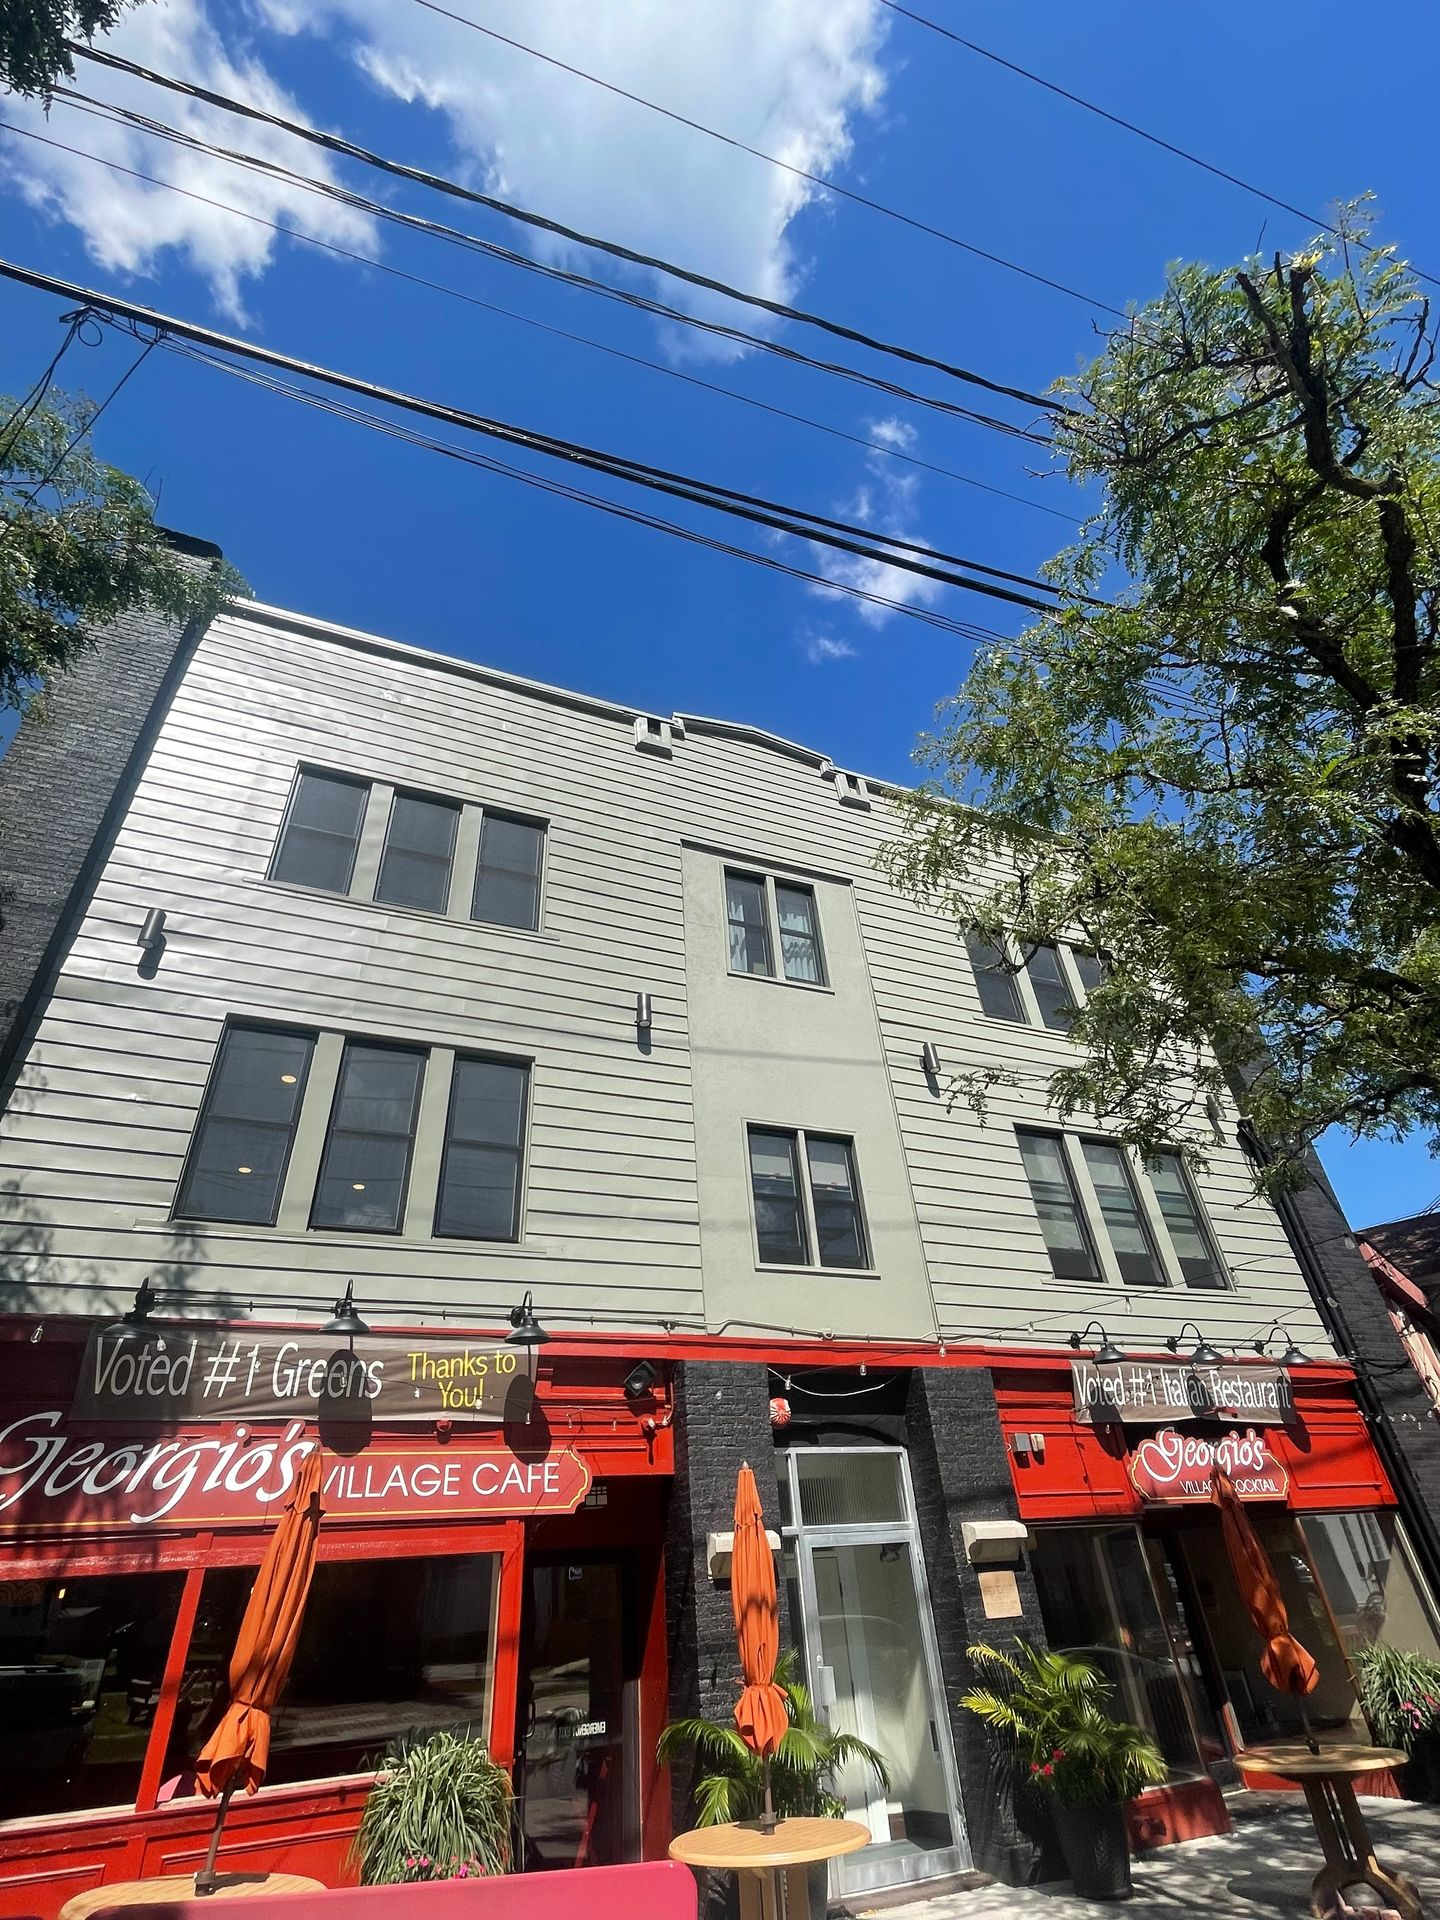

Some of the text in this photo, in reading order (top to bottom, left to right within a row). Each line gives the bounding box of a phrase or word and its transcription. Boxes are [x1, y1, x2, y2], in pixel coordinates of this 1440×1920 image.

[94, 1336, 385, 1399] Voted #1 Greens
[407, 1350, 517, 1381] Thanks to
[1073, 1364, 1292, 1409] Voted #1 Italian Restaurant
[438, 1378, 484, 1409] You!
[0, 1411, 317, 1524] Georgio's
[472, 1462, 560, 1495] CAFE
[1141, 1426, 1265, 1482] Georgio's
[1179, 1478, 1279, 1495] VILLA OCKTAIL
